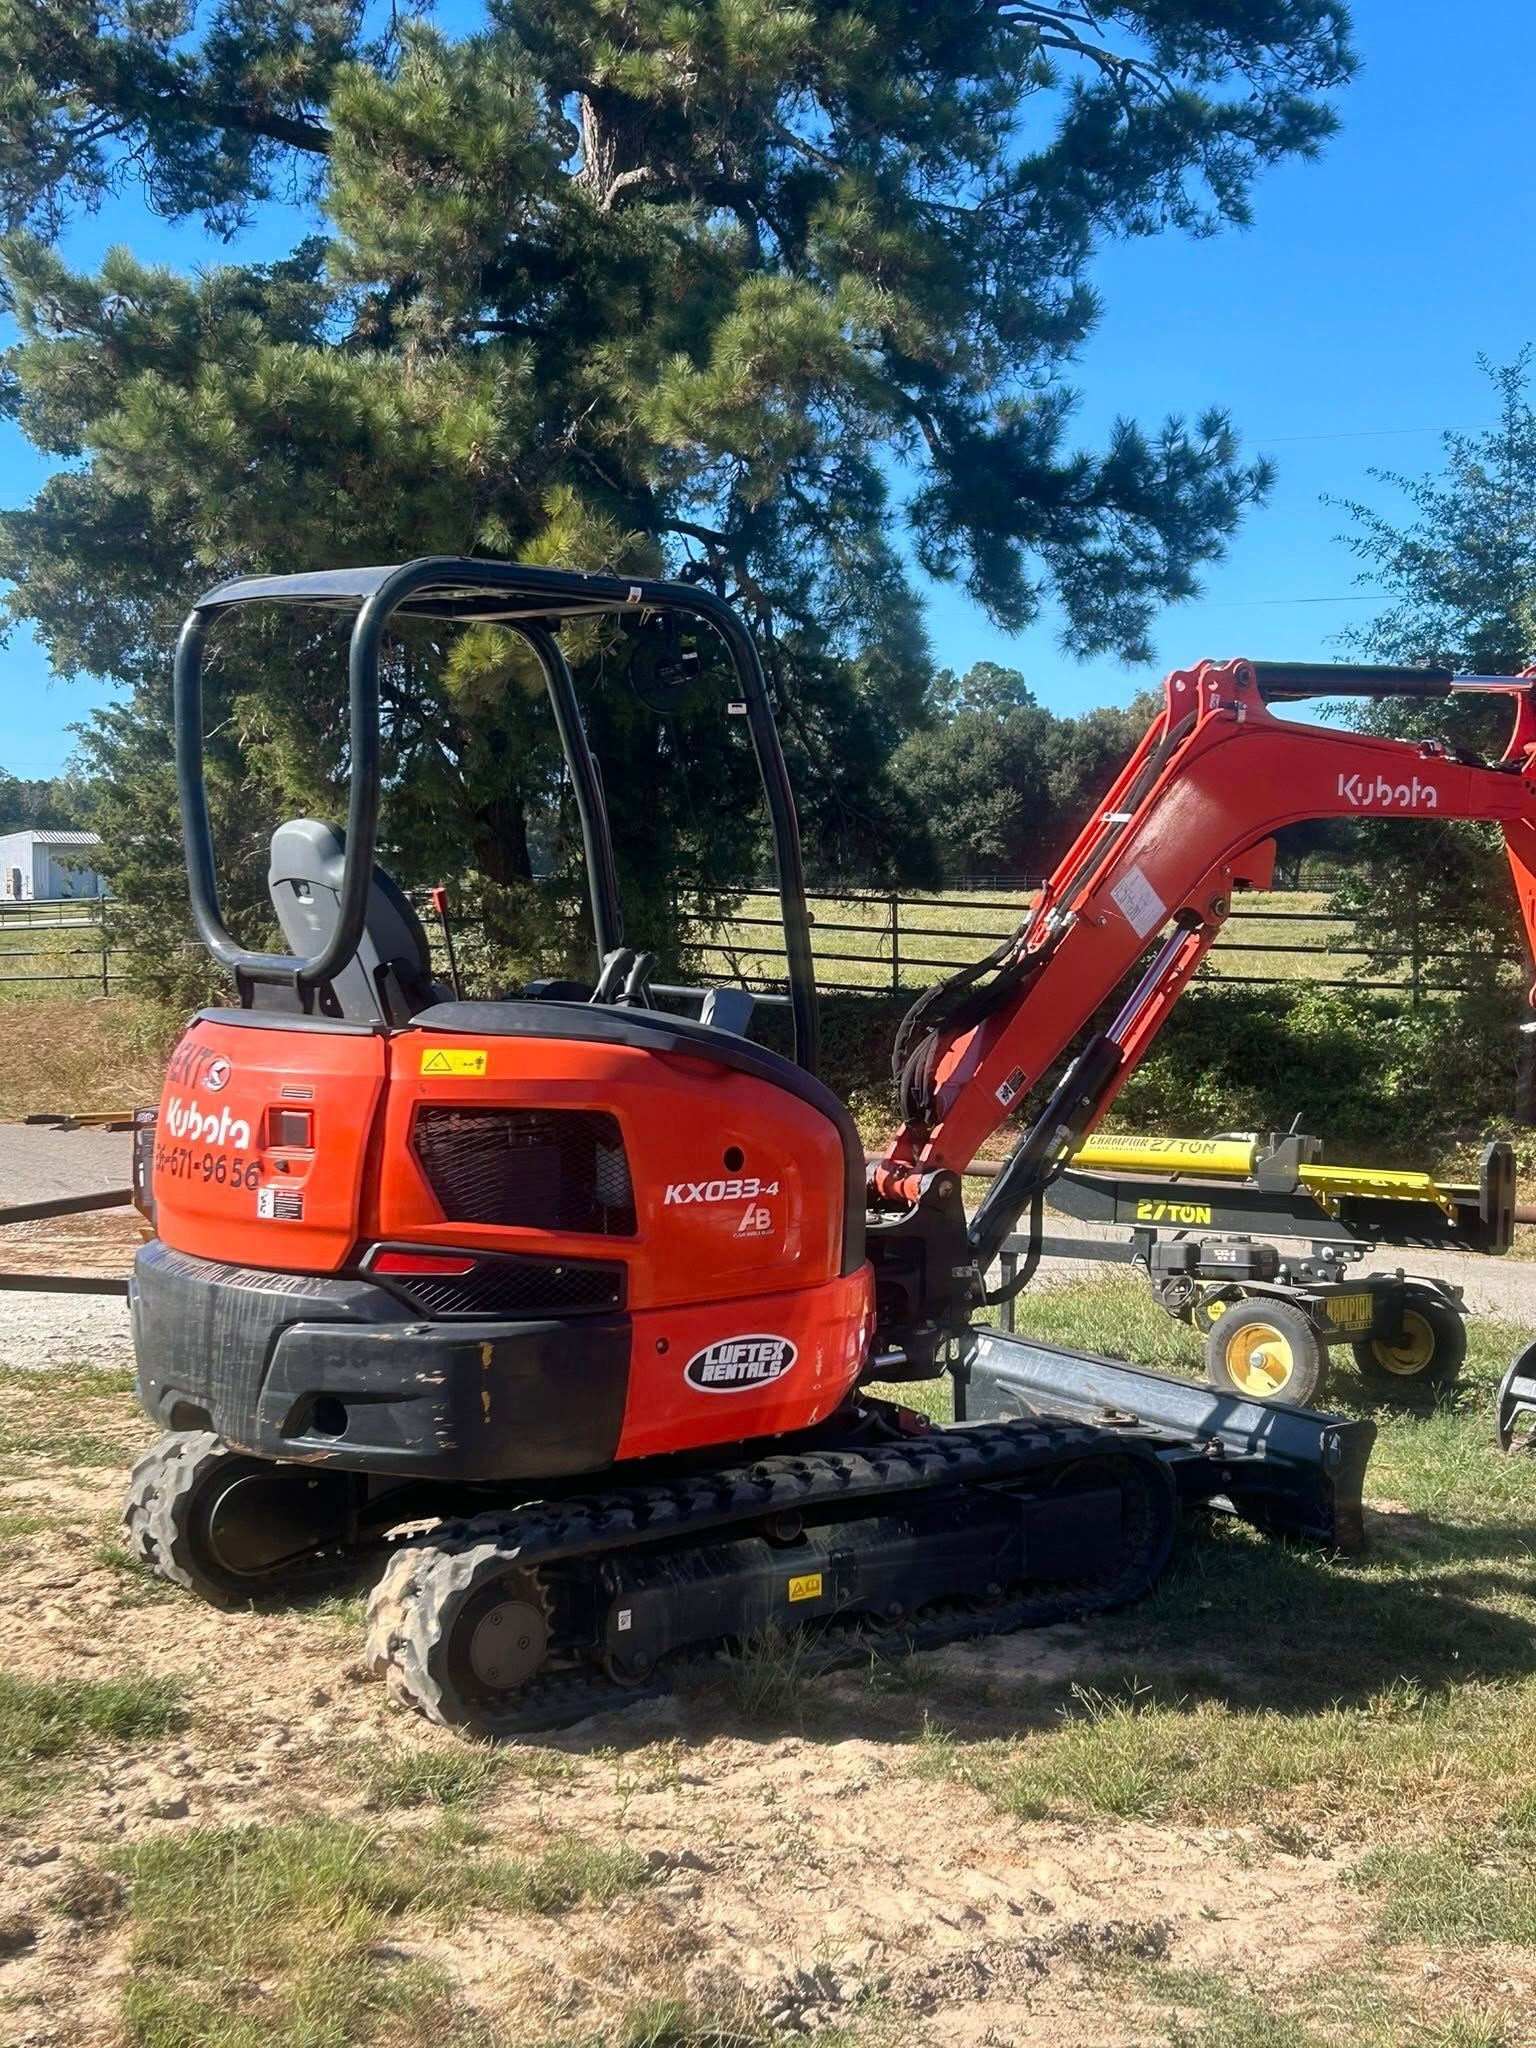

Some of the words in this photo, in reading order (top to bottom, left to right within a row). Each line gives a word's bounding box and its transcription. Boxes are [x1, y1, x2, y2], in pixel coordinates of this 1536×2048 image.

[1337, 773, 1437, 808] Kubota
[164, 1097, 250, 1150] Kubota
[1089, 1136, 1147, 1147] CHAMPION
[664, 1178, 779, 1205] KX033-4
[704, 1341, 786, 1365] LUFTEX
[701, 1360, 782, 1382] RENTALS
